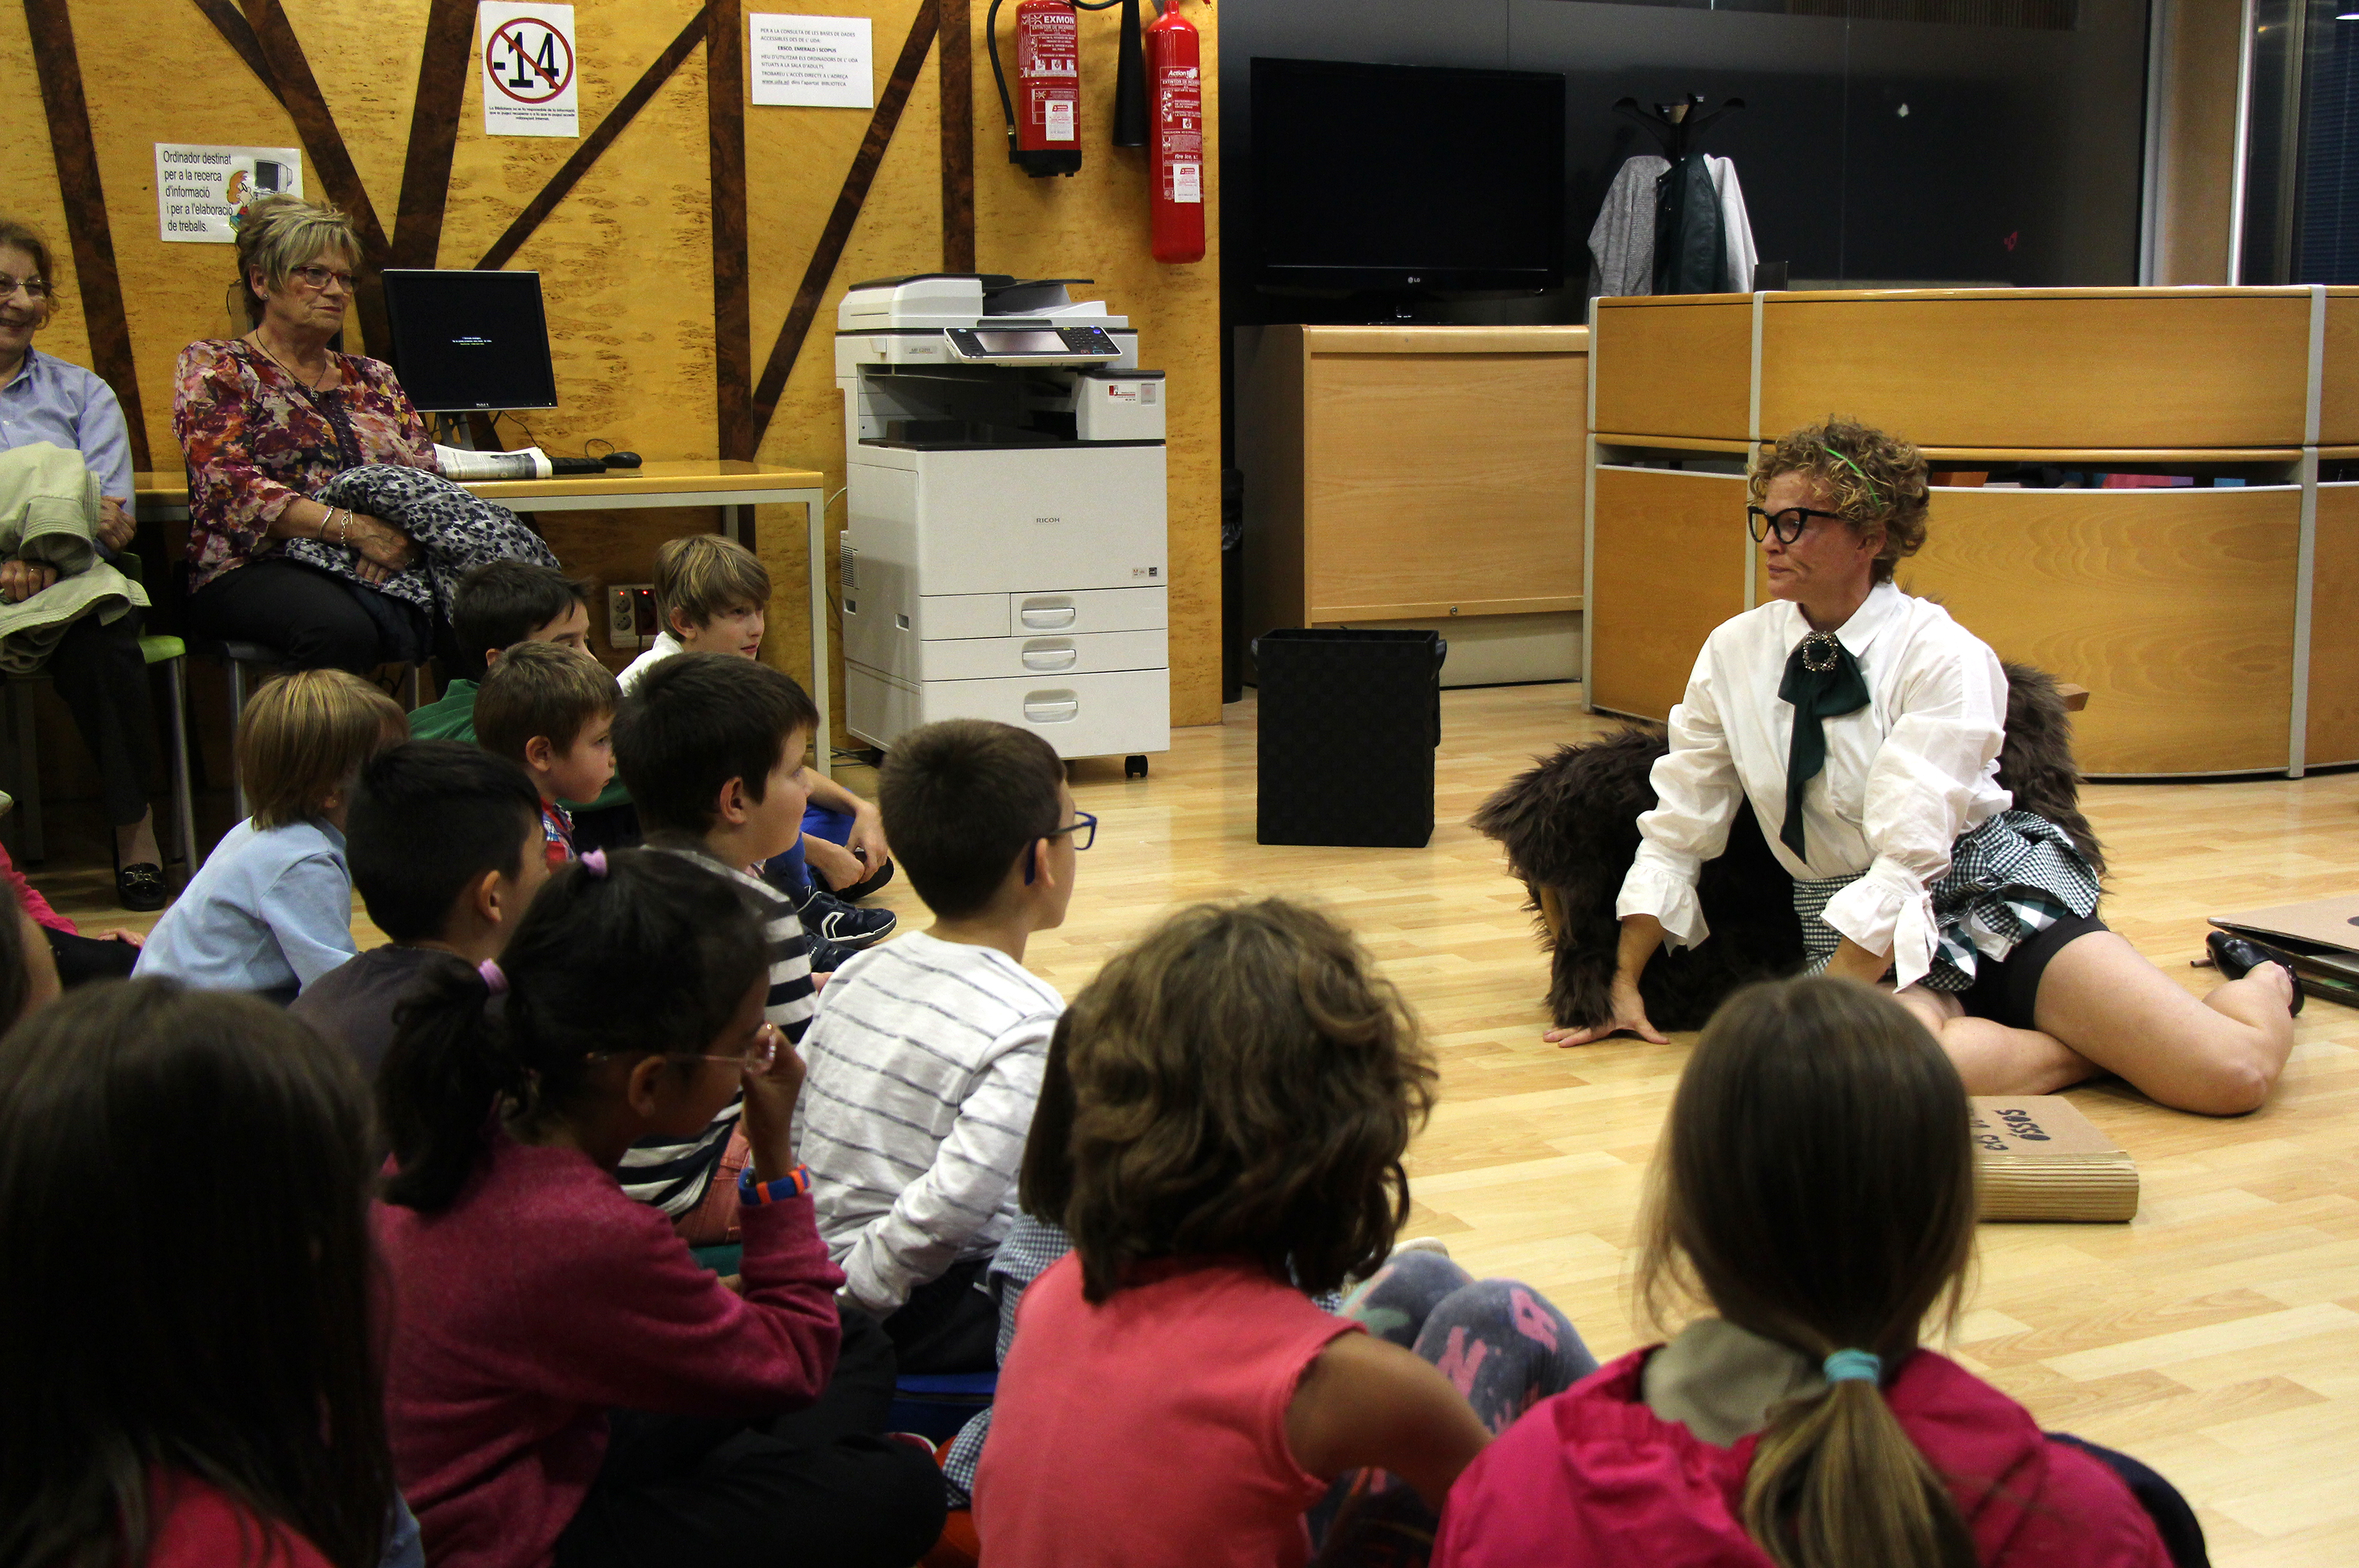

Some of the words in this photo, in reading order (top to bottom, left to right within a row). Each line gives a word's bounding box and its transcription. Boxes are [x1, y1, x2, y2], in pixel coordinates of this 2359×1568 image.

[1044, 16, 1074, 24] EXMON
[164, 151, 200, 164] Ordinador
[203, 152, 231, 164] destinat
[165, 170, 177, 182] per
[179, 172, 183, 180] a
[186, 169, 192, 180] la
[195, 172, 222, 181] recerca
[167, 203, 169, 214] i
[171, 205, 183, 216] per
[185, 206, 190, 214] a
[168, 220, 177, 231] de
[179, 220, 208, 232] treballs.
